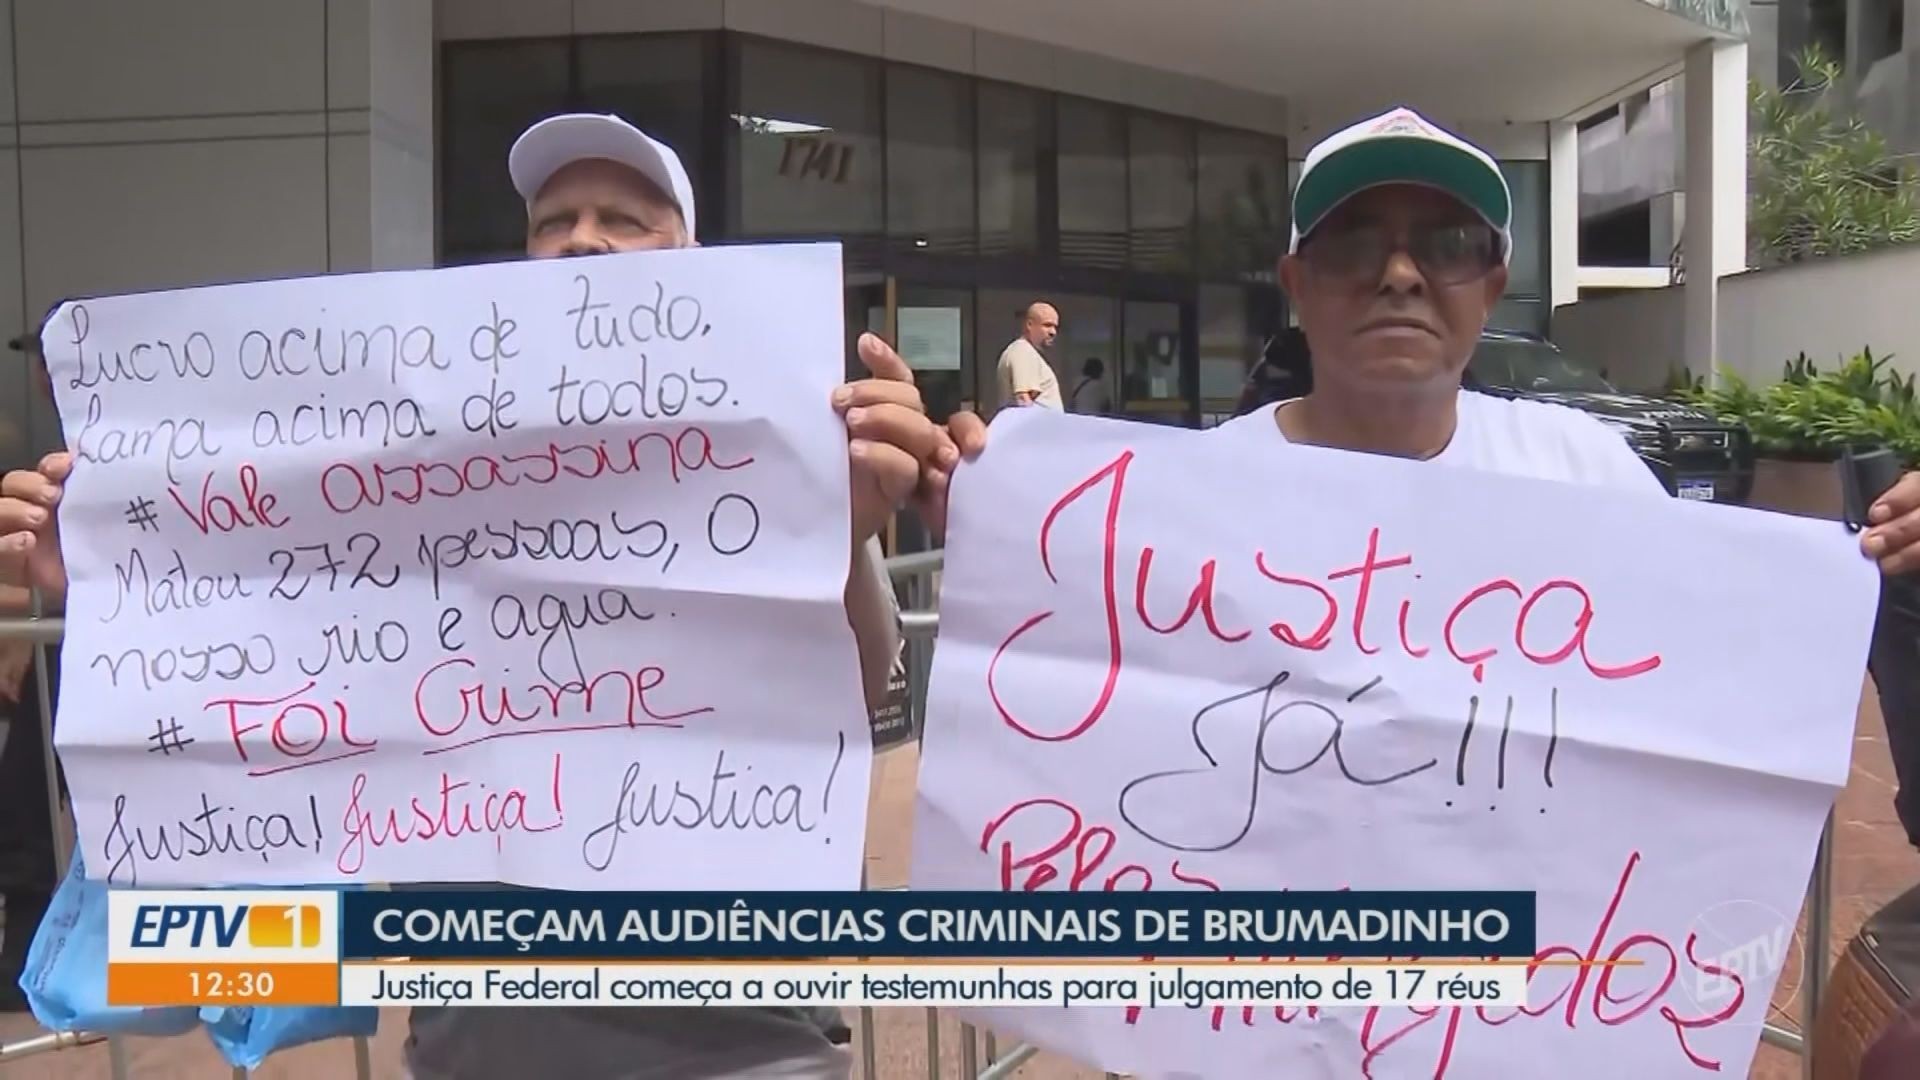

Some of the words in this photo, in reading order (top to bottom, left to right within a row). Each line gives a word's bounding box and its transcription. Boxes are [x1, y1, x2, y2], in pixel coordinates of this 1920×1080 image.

[239, 307, 450, 383] acima
[470, 302, 520, 373] de
[252, 393, 436, 446] acima
[462, 378, 517, 438] de
[549, 354, 738, 425] todos.
[321, 427, 754, 514] assassina
[269, 533, 400, 600] 272
[988, 450, 1661, 741] Justiça
[91, 635, 275, 690] nosso
[298, 615, 408, 675] rio
[439, 608, 465, 651] e
[415, 659, 714, 735] Crime
